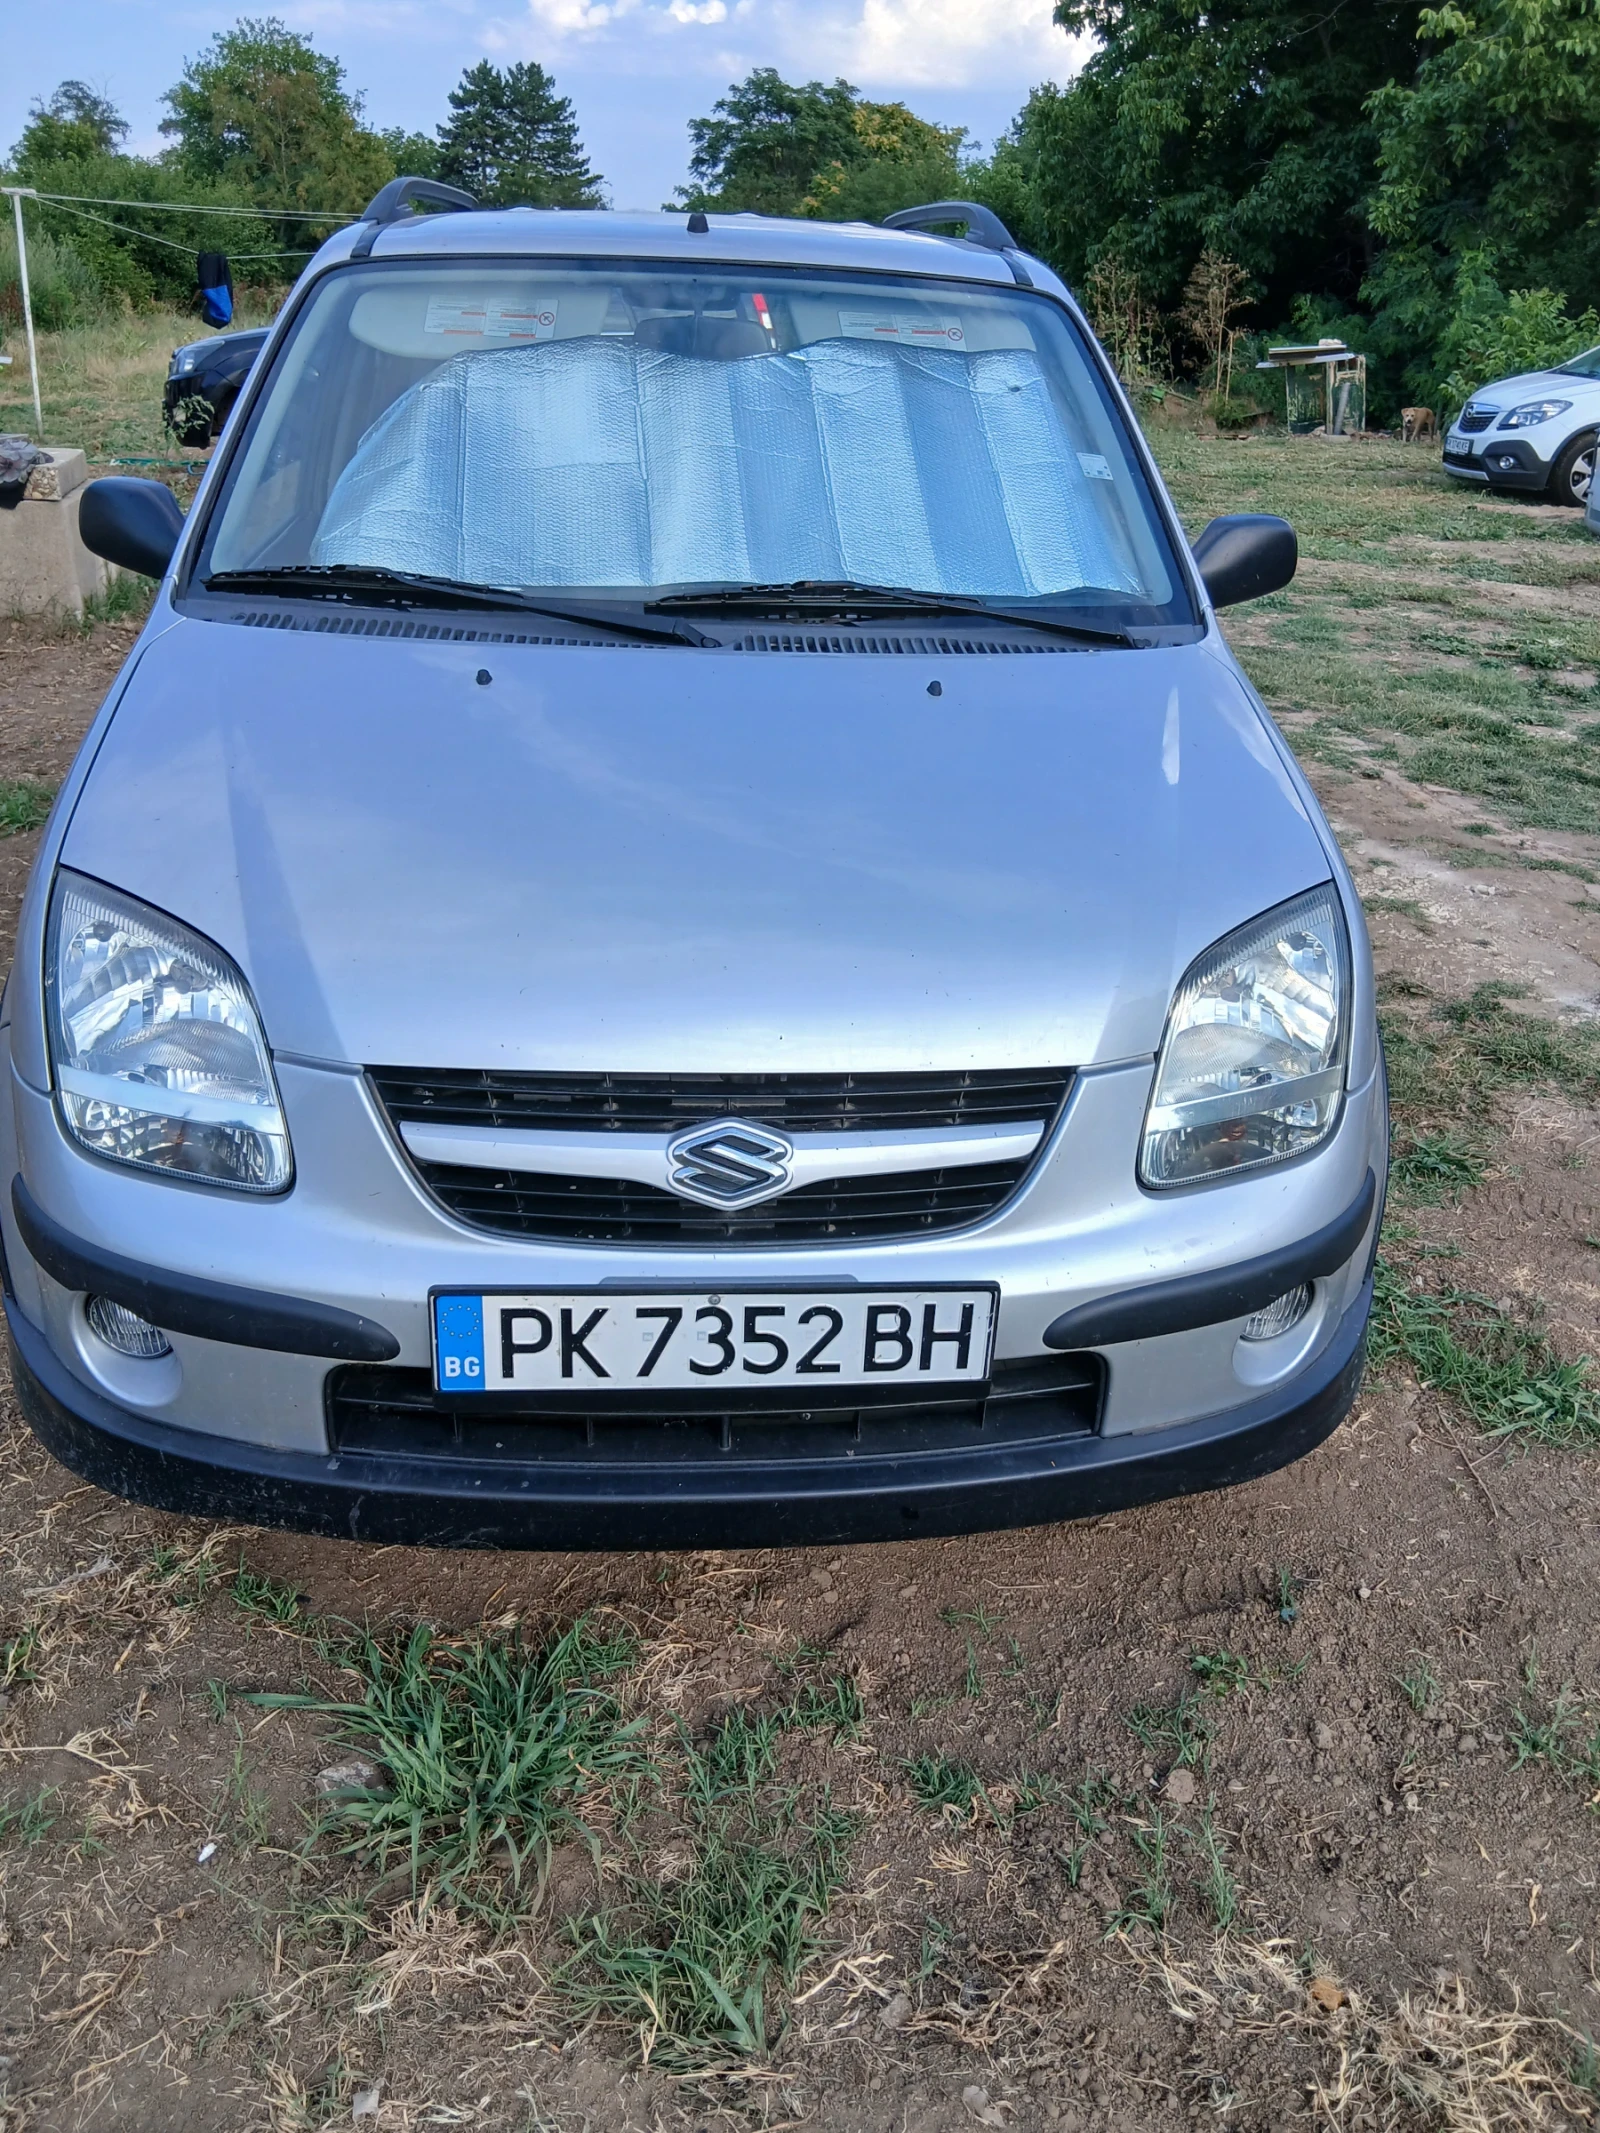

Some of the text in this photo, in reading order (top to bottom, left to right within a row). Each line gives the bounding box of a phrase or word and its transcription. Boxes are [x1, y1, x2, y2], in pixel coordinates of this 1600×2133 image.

[500, 1304, 975, 1378] PK 7352 BH
[445, 1356, 480, 1377] BG
